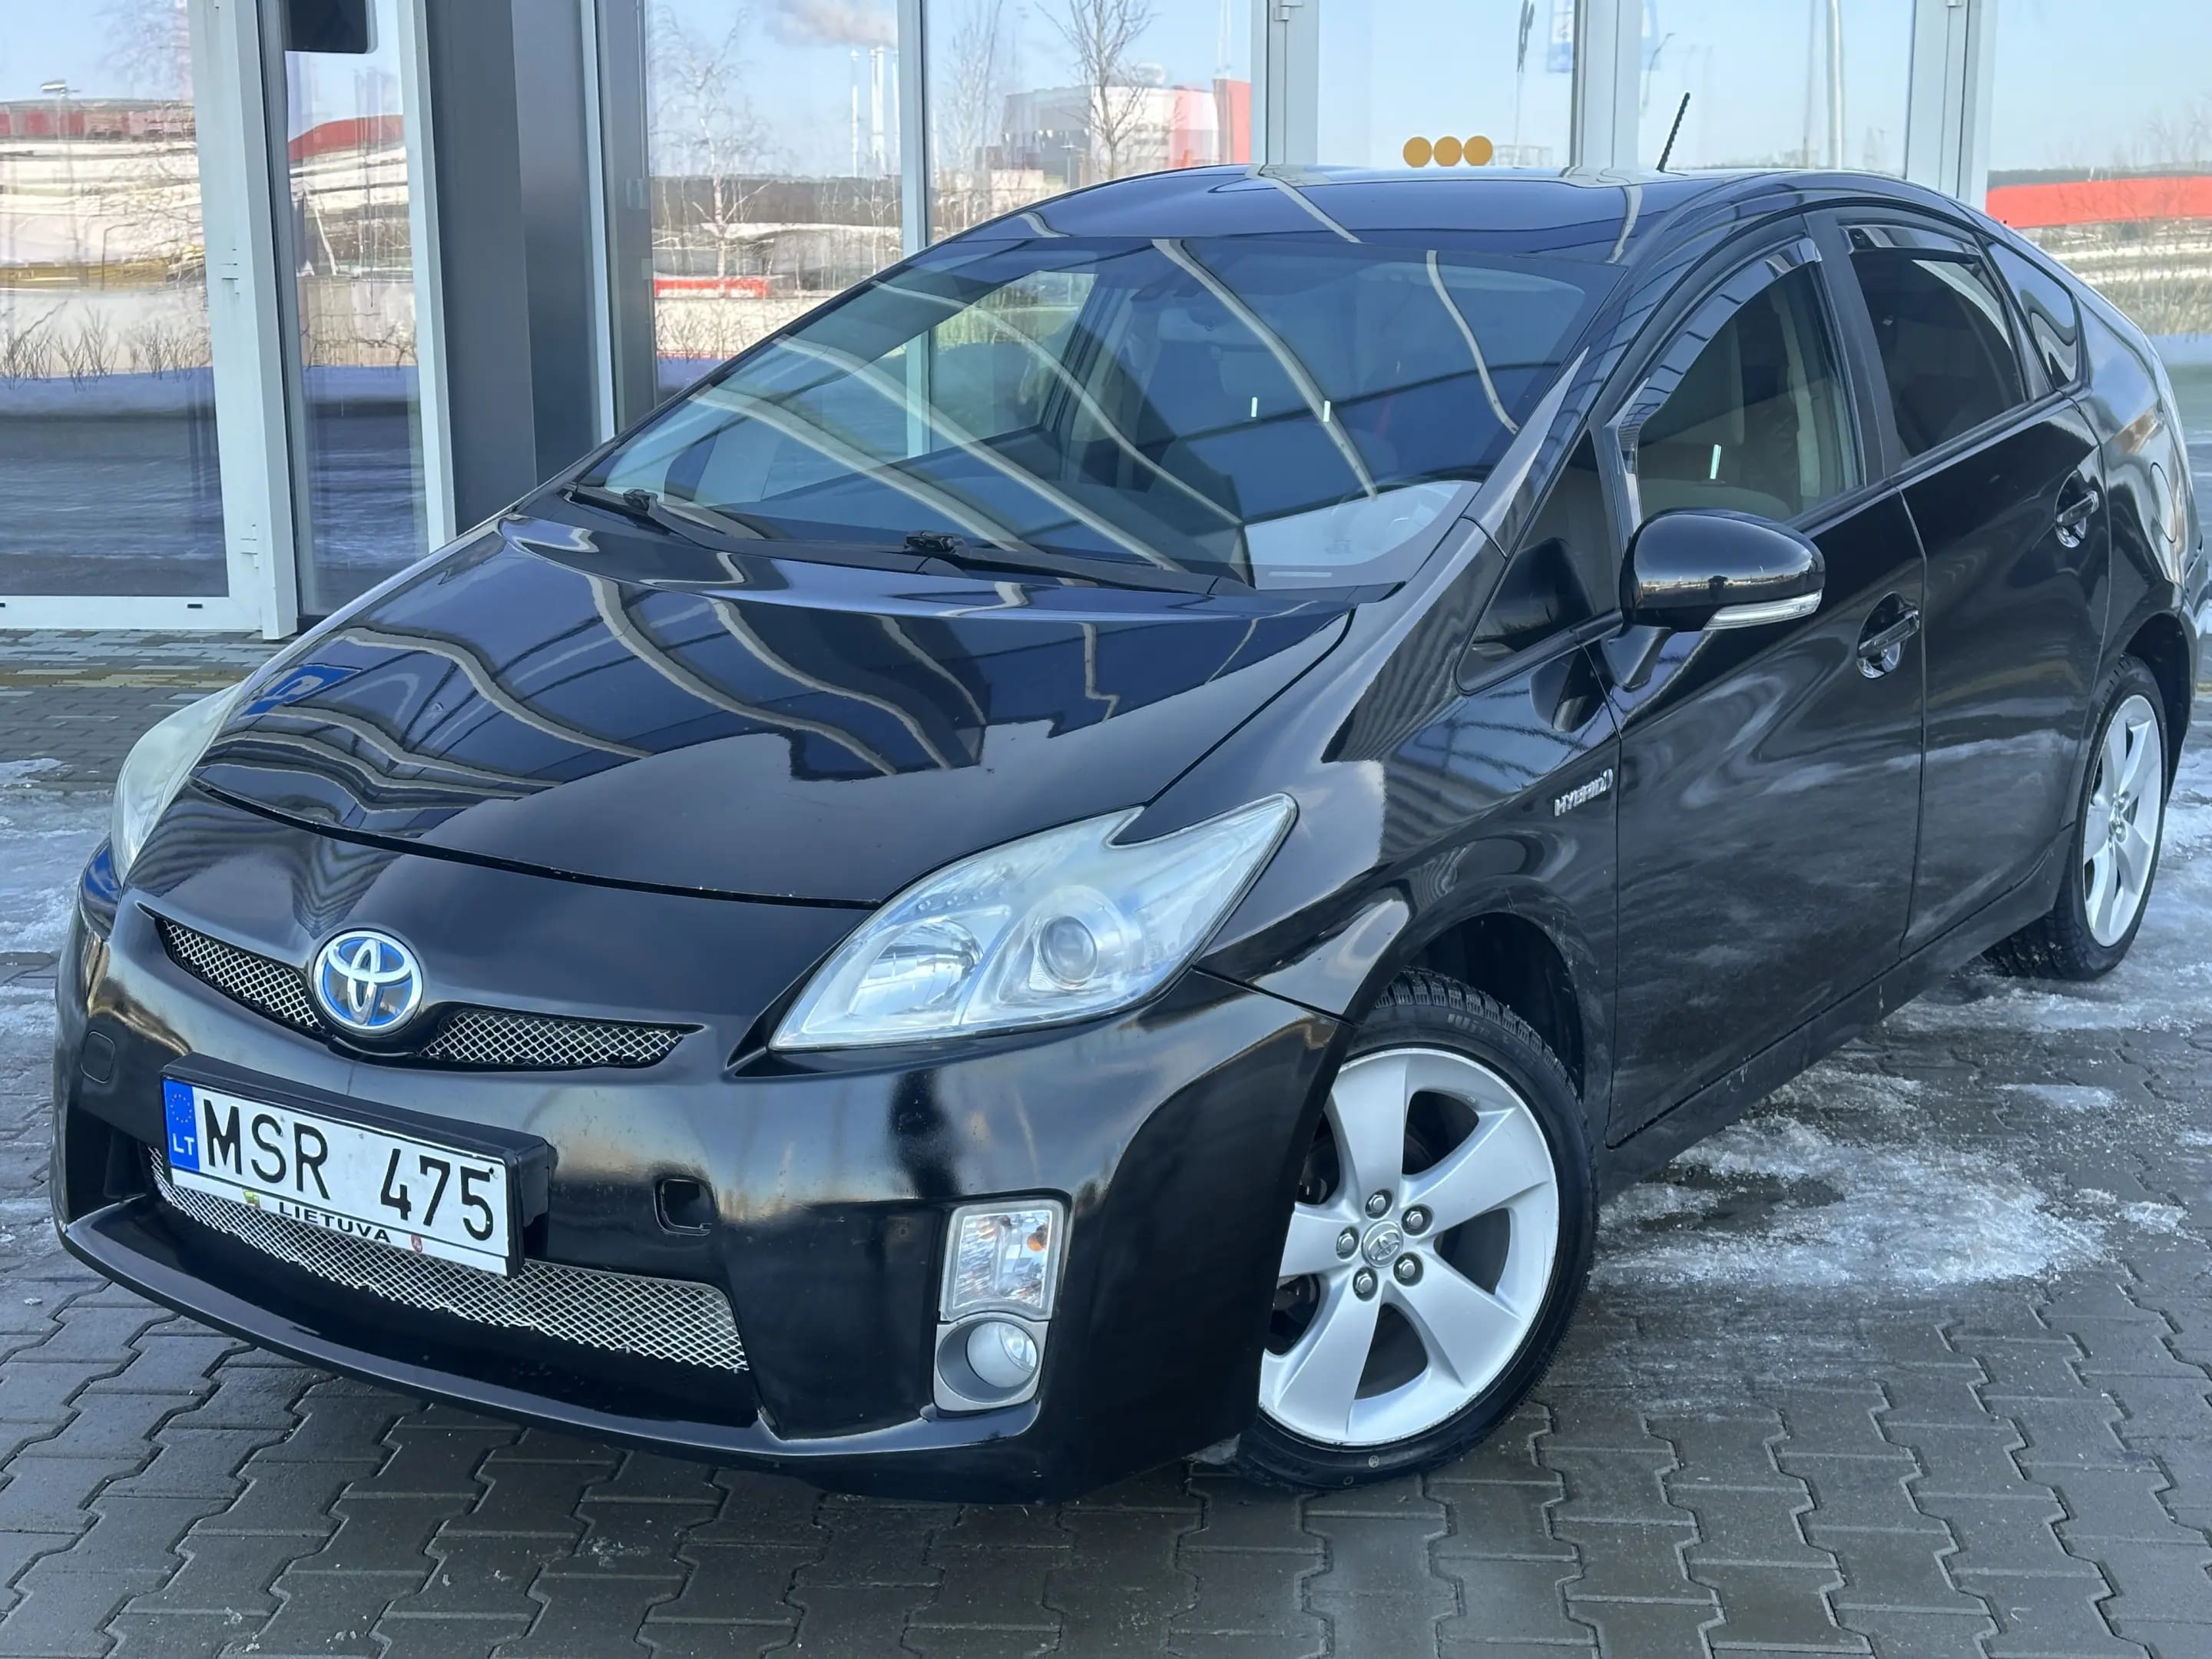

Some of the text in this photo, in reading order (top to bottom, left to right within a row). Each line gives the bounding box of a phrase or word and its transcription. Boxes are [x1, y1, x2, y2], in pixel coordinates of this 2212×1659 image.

[1554, 769, 1613, 816] HYBRID
[172, 1133, 195, 1156] LT
[203, 1098, 494, 1241] MSR 475
[279, 1201, 391, 1243] LIETUVA
